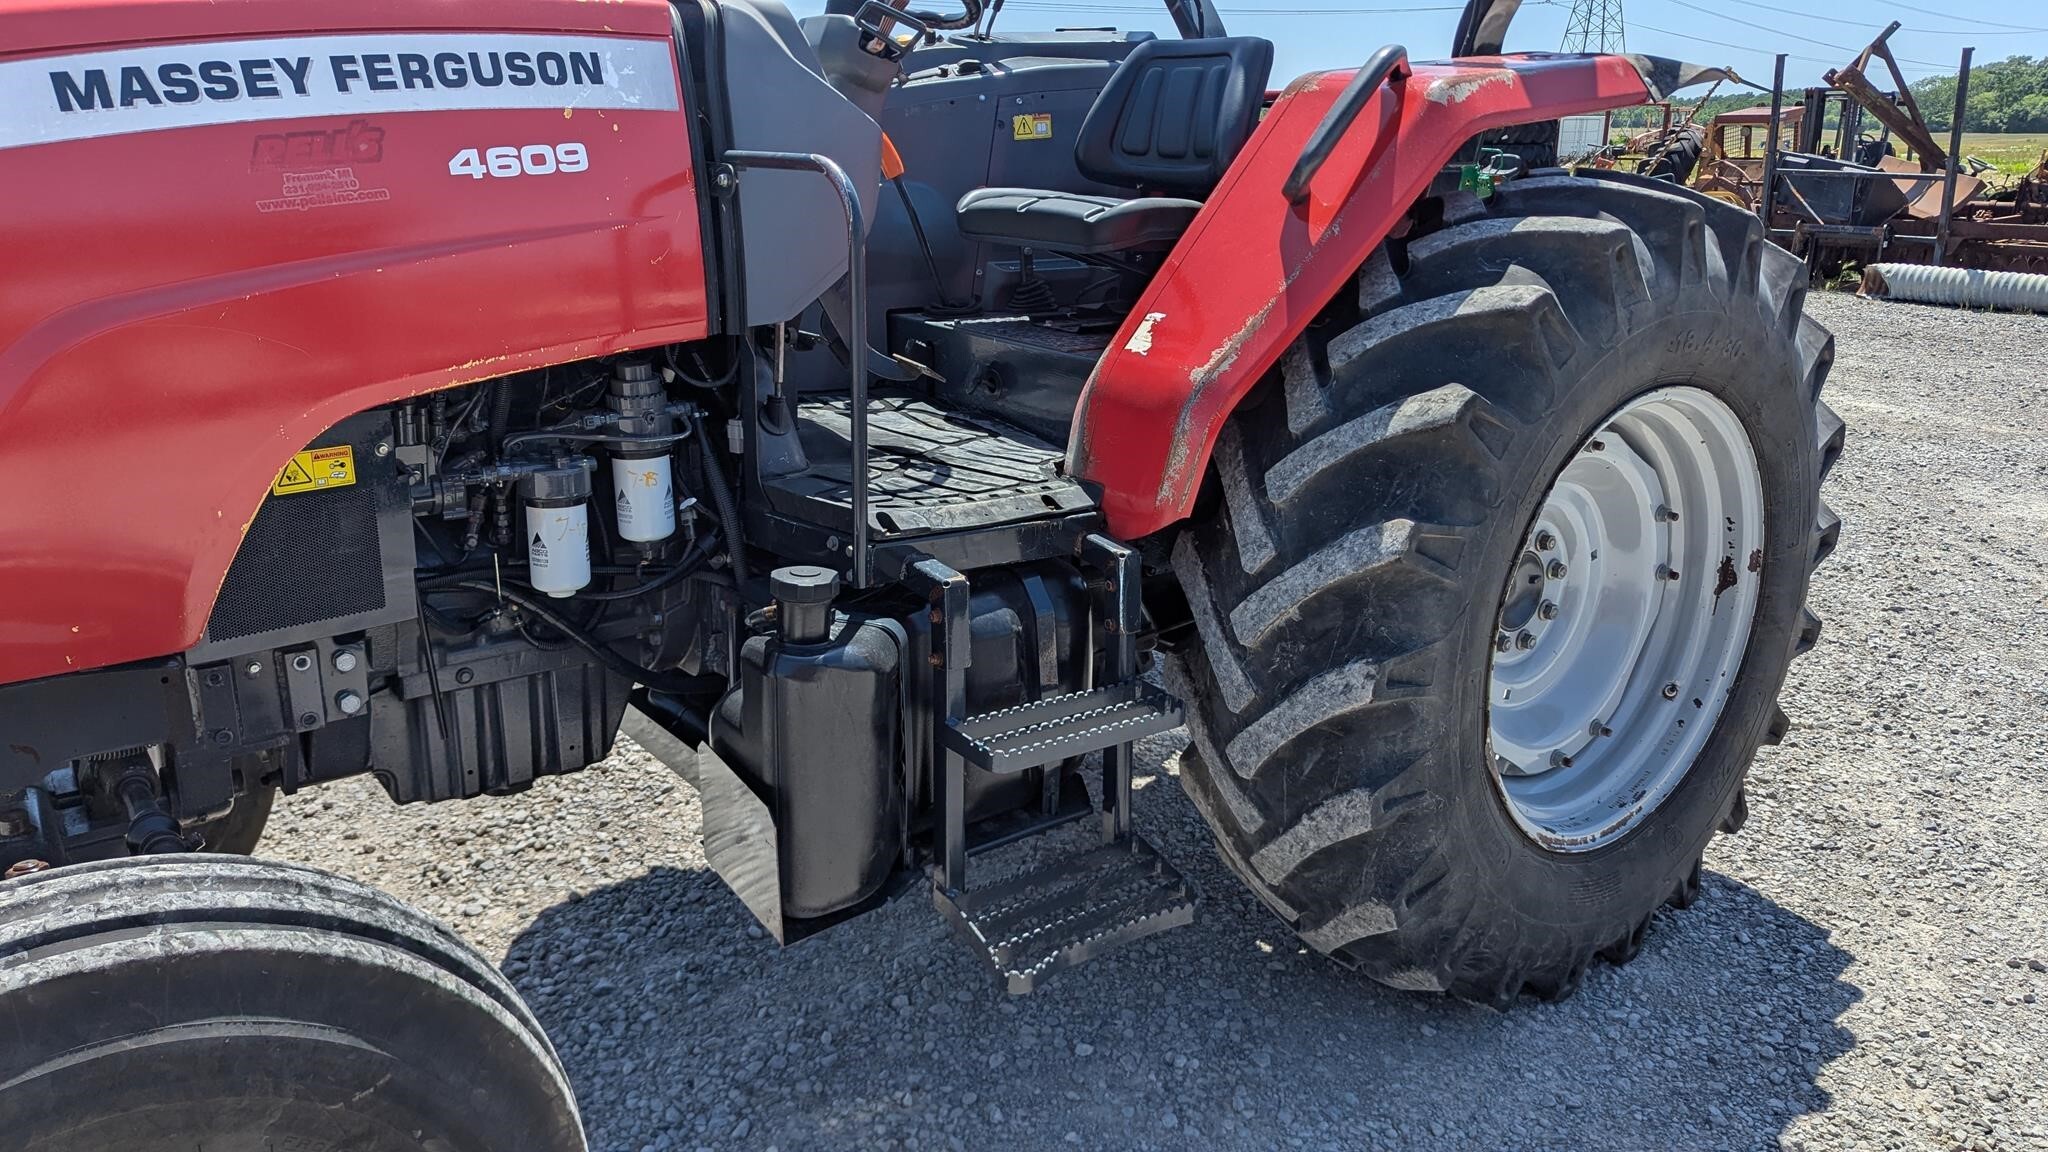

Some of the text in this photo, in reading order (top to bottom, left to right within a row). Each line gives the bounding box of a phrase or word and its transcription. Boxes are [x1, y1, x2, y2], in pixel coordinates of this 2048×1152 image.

[49, 52, 605, 113] MASSEY FERGUSON
[448, 142, 589, 179] 4609
[319, 450, 349, 459] WARNING
